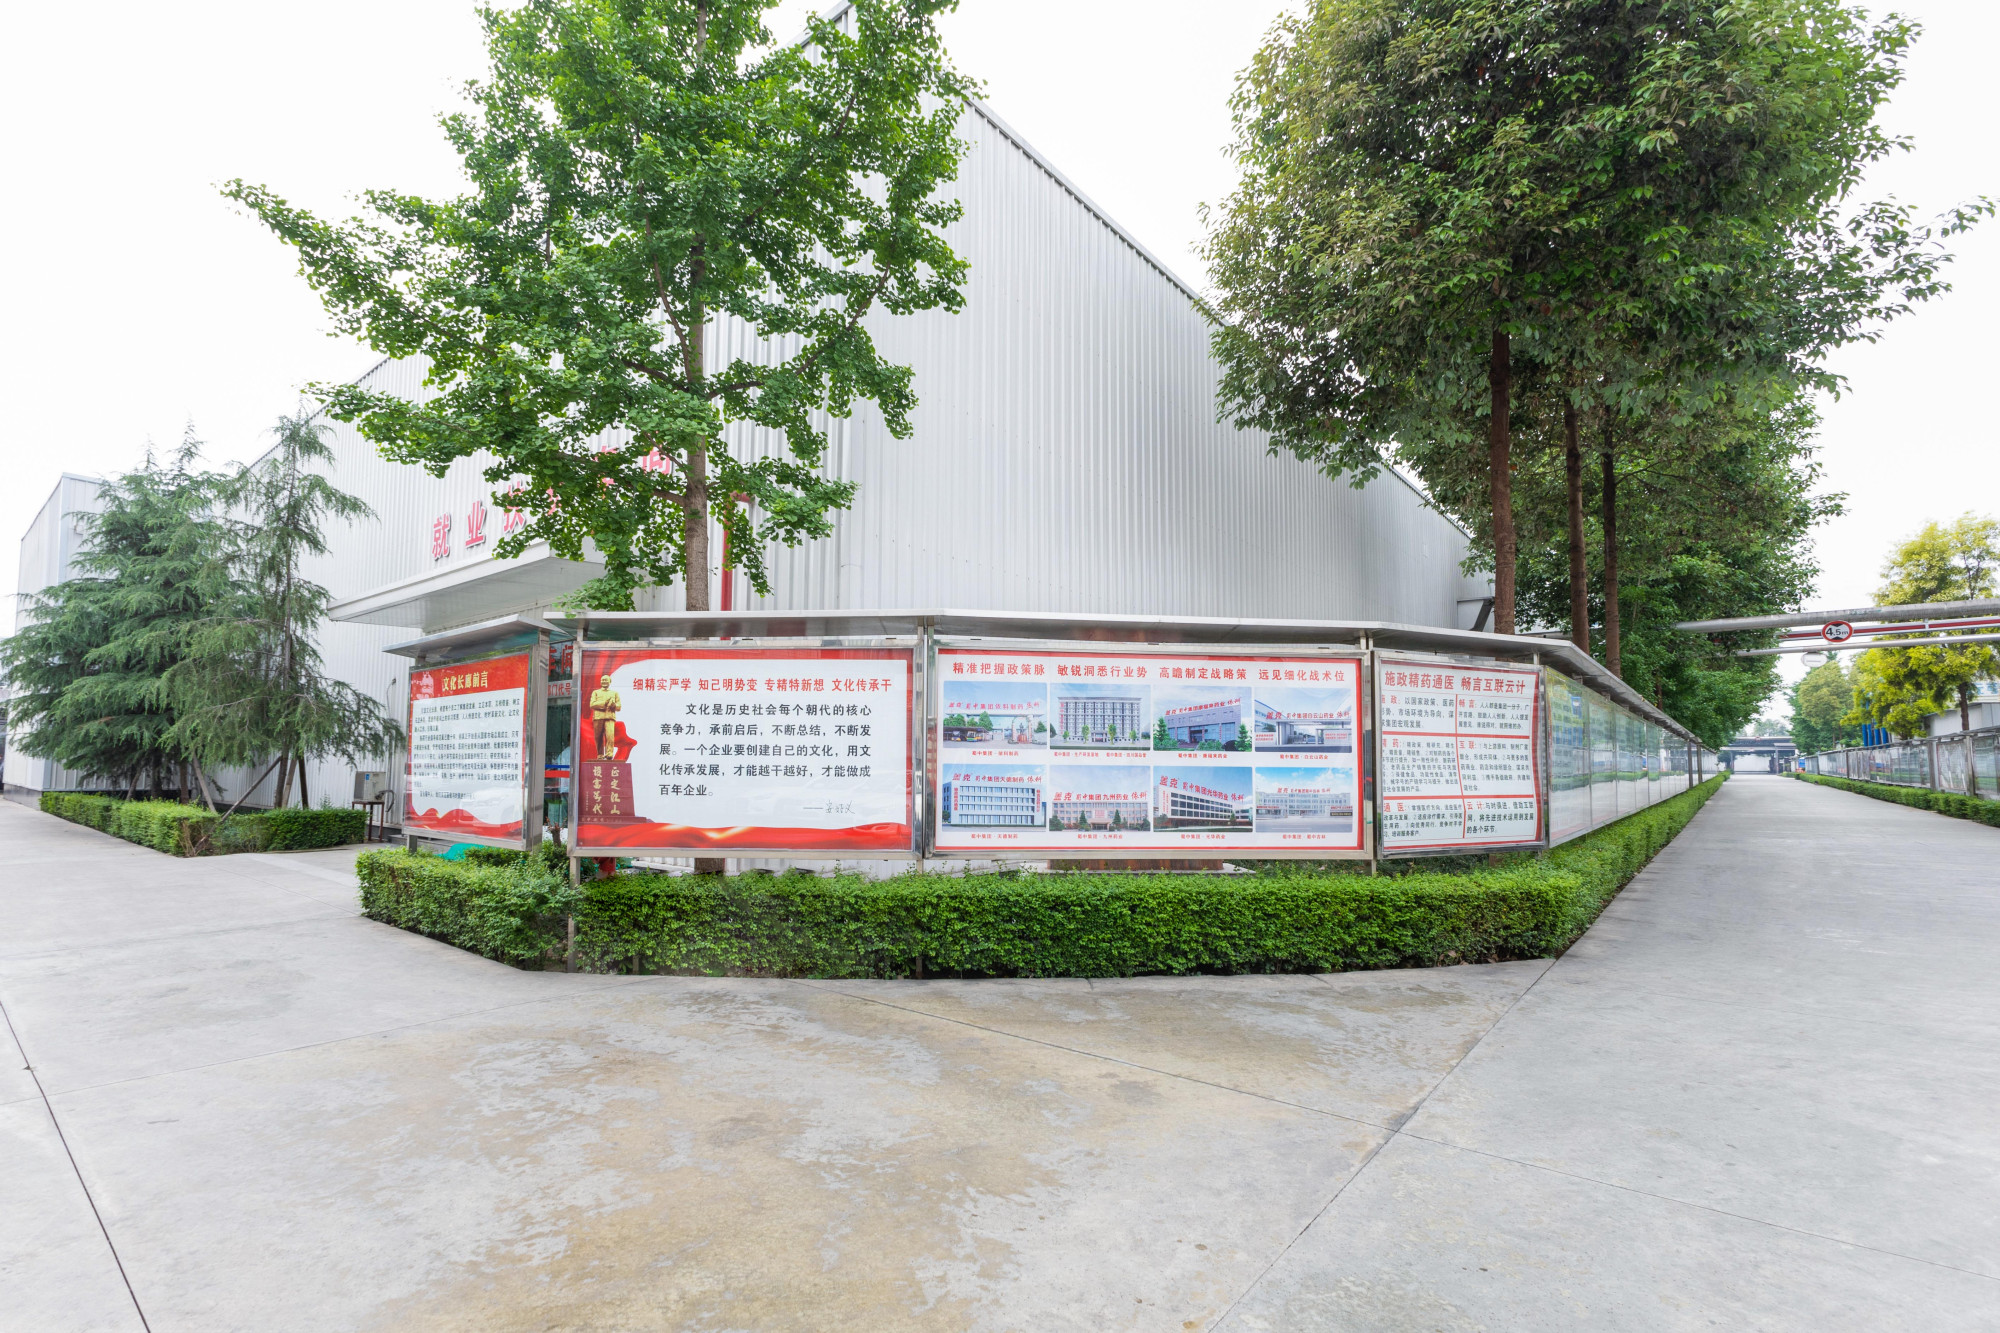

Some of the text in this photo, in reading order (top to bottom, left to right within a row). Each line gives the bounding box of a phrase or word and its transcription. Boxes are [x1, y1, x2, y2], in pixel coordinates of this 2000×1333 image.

[1826, 627, 1849, 636] 4.5m
[953, 662, 1345, 682] 精准把握政策脉 敏锐洞悉行业势 高瞻制定战略策 远见细化战术位
[442, 671, 489, 692] 文化长廊前言
[632, 677, 893, 692] 细精实严学 知己明势变 专精特新想 文化传承干
[1384, 670, 1526, 695] 施政精药通医 畅言互联云计
[685, 703, 872, 717] 文化是历史社会每个朝代的核心
[660, 723, 872, 737] 竞争力，承前启后，不断总结，不断发
[659, 743, 872, 758] 展。一个企业要创建自己的文化，用文
[658, 763, 872, 778] 化传承发展，才能越干越好，才能做成
[658, 784, 714, 797] 百年企业。
